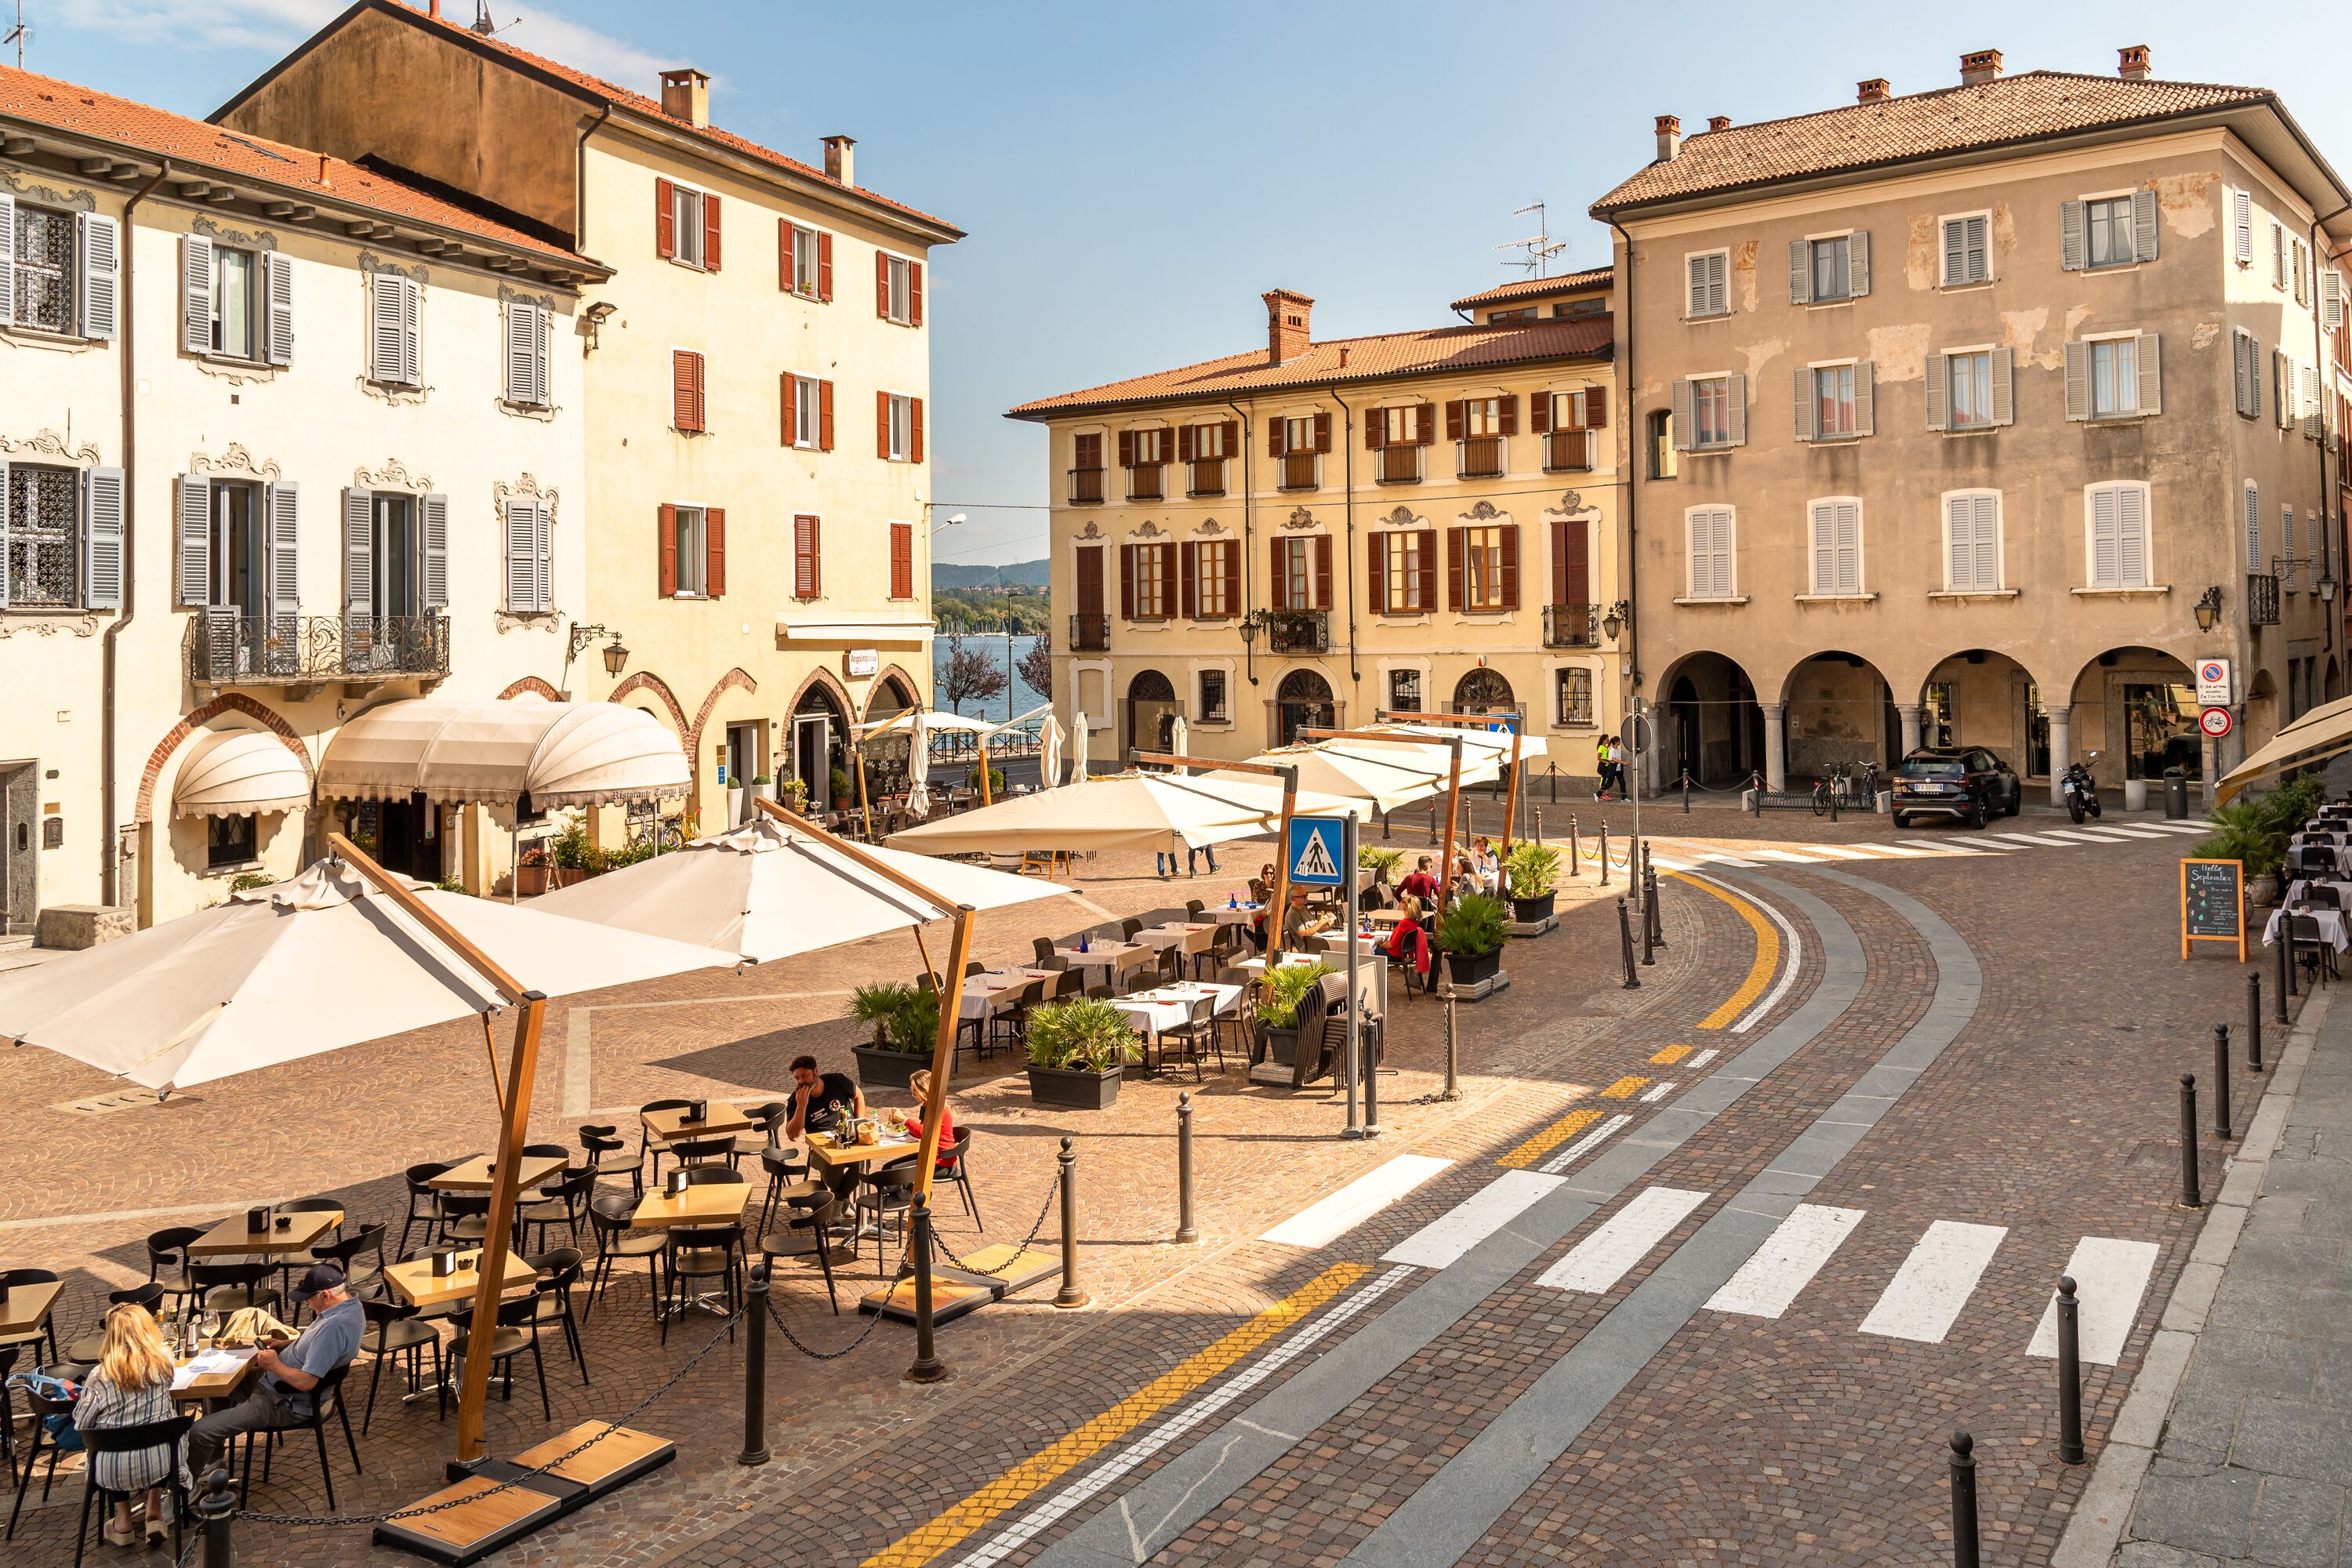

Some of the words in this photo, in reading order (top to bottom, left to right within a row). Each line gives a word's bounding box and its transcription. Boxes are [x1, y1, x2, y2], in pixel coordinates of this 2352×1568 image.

[612, 790, 652, 800] Ristorante
[654, 787, 677, 797] Taverna
[2191, 869, 2232, 884] September
